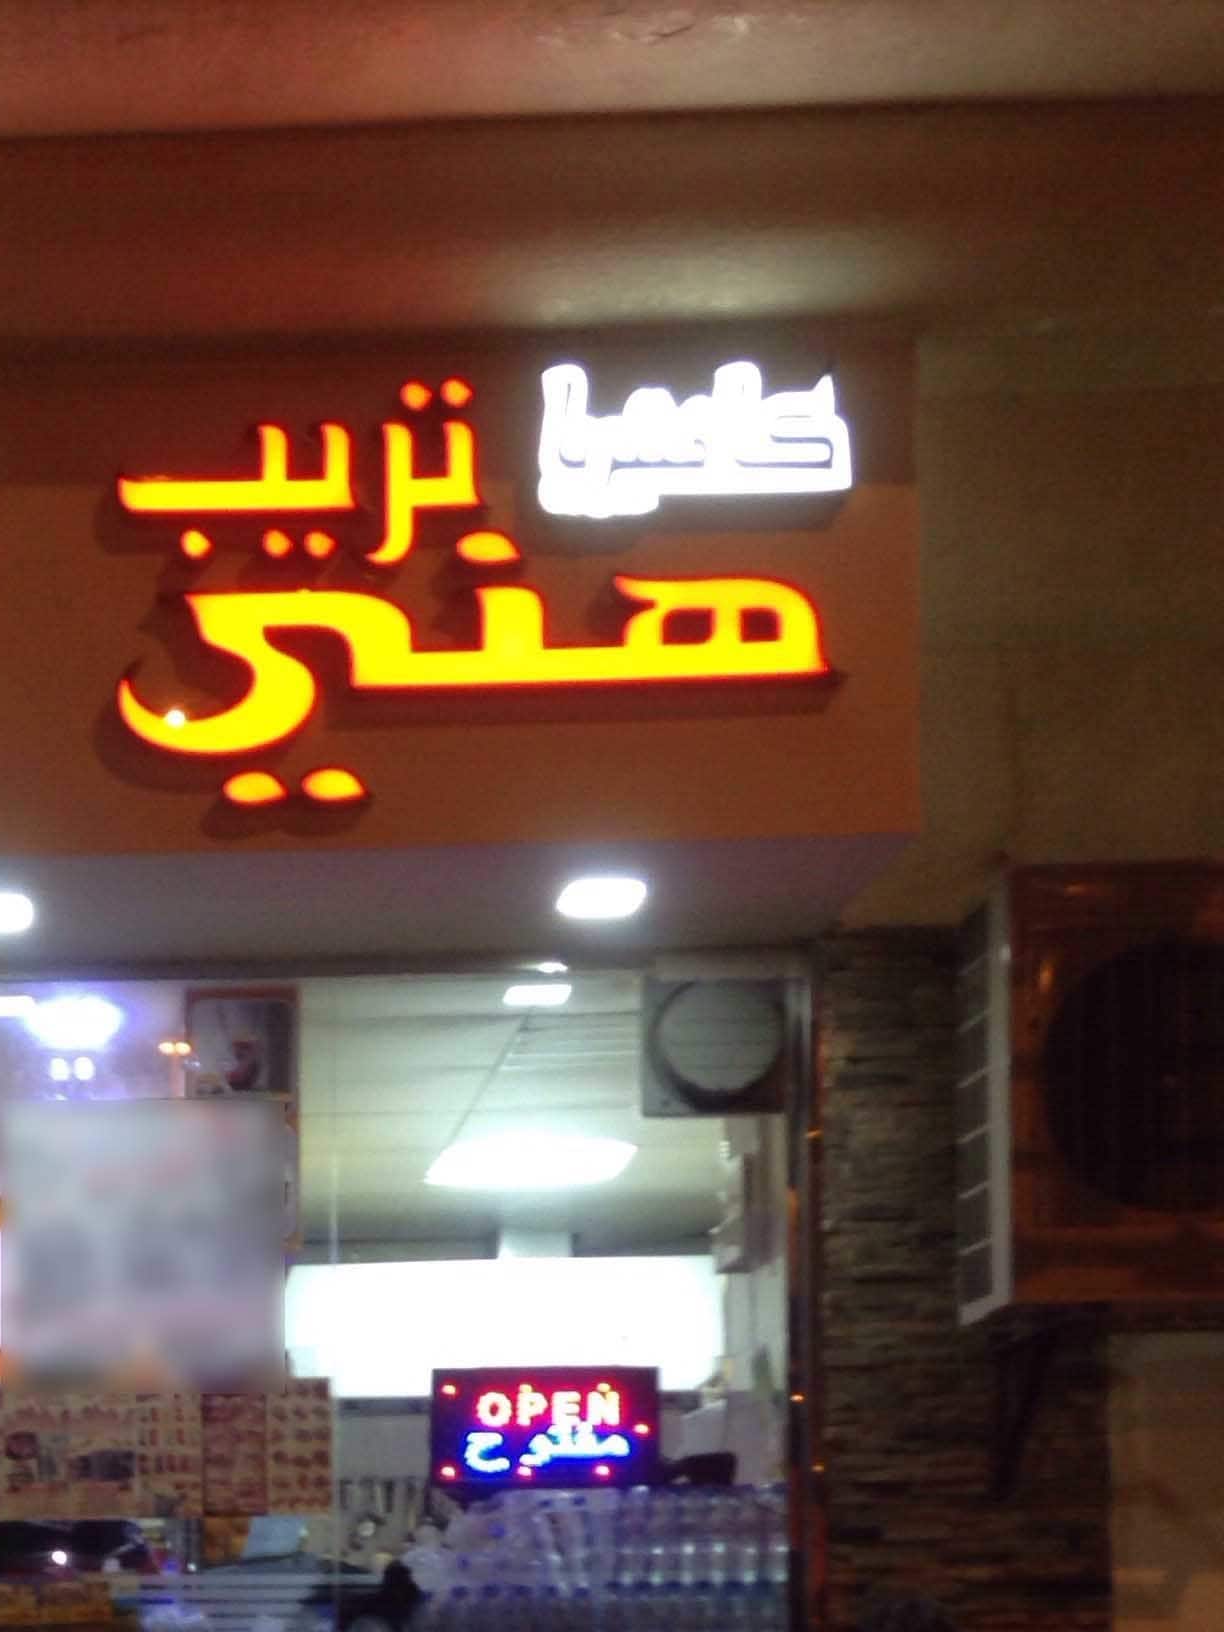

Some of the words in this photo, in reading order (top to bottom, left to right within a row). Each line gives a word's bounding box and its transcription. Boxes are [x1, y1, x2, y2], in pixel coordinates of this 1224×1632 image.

[118, 379, 480, 565] تريب
[118, 531, 825, 804] هني
[463, 1420, 631, 1472] مفتوح
[477, 1391, 620, 1427] OPEN
